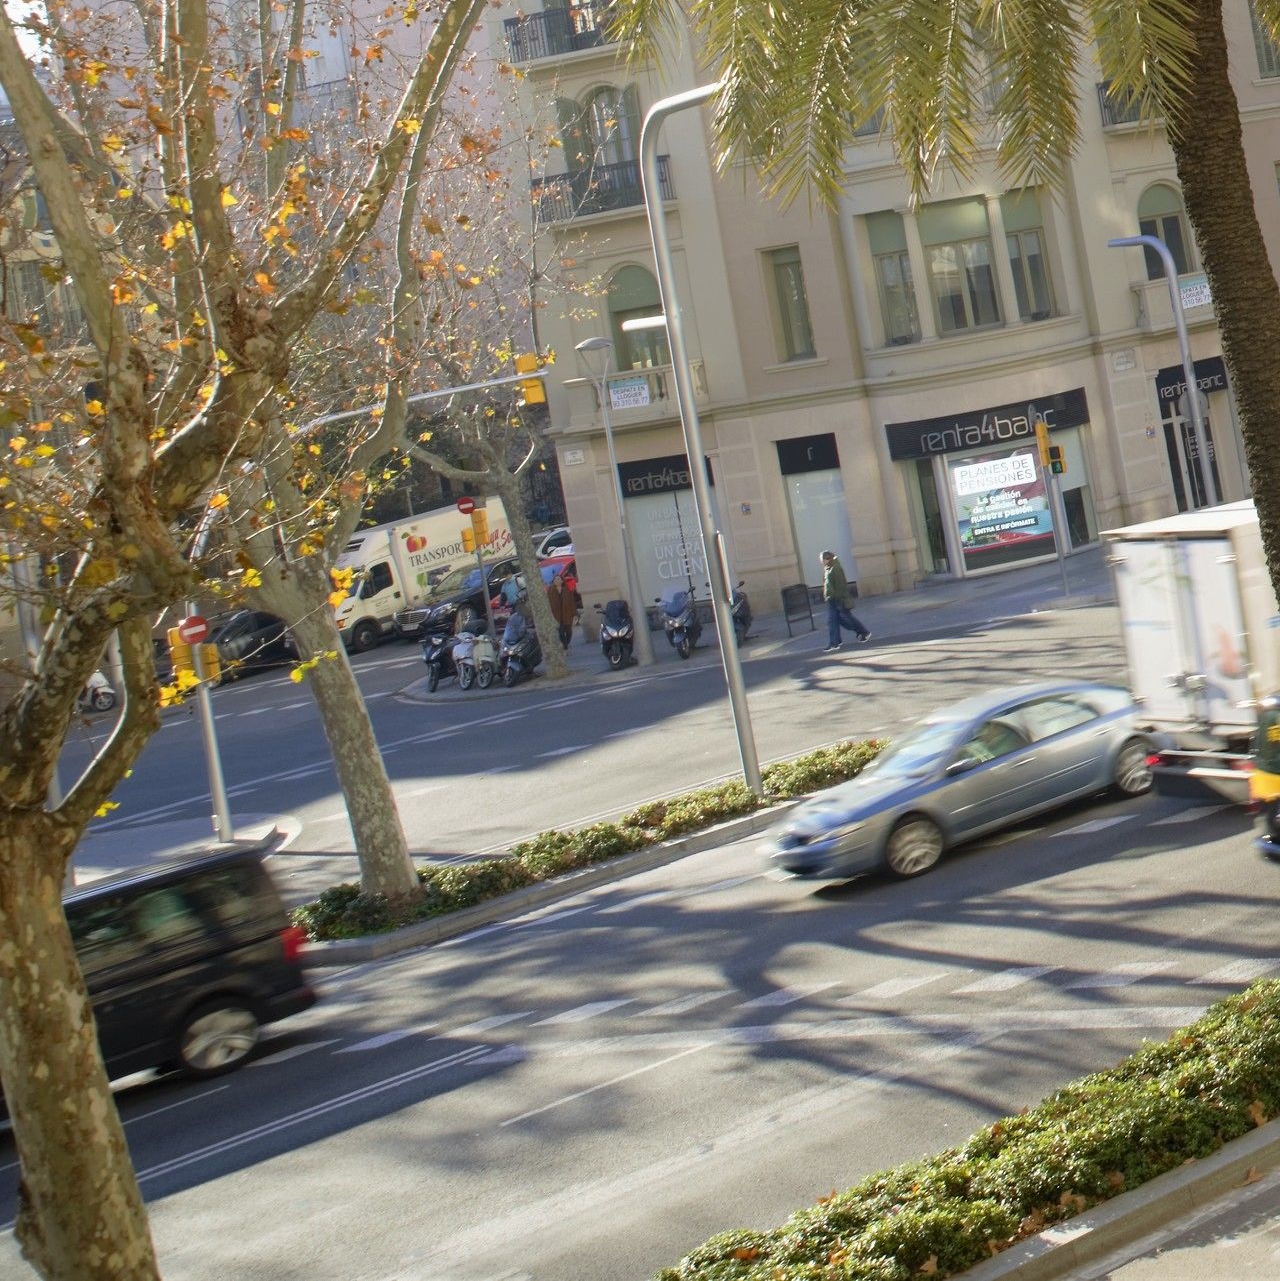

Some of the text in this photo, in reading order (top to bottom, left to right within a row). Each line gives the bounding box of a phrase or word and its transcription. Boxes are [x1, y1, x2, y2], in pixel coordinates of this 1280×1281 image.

[1181, 290, 1205, 299] LOGUER
[1182, 286, 1199, 294] SPATX
[1161, 374, 1223, 398] rentabanc
[617, 392, 642, 401] LLOGUER
[920, 408, 1056, 453] renta4banc
[961, 458, 1029, 479] PLANES DE
[627, 467, 689, 492] renta4ba
[960, 469, 1033, 491] PENSIONES
[977, 489, 1021, 505] La gestión
[971, 511, 1003, 524] nuestra
[973, 506, 984, 514] de
[974, 527, 996, 535] ENTRA
[1001, 518, 1036, 530] INFÓRMATE
[408, 542, 465, 567] TRANSPOR
[655, 541, 701, 559] UN GRA
[658, 557, 704, 579] CLIEN
